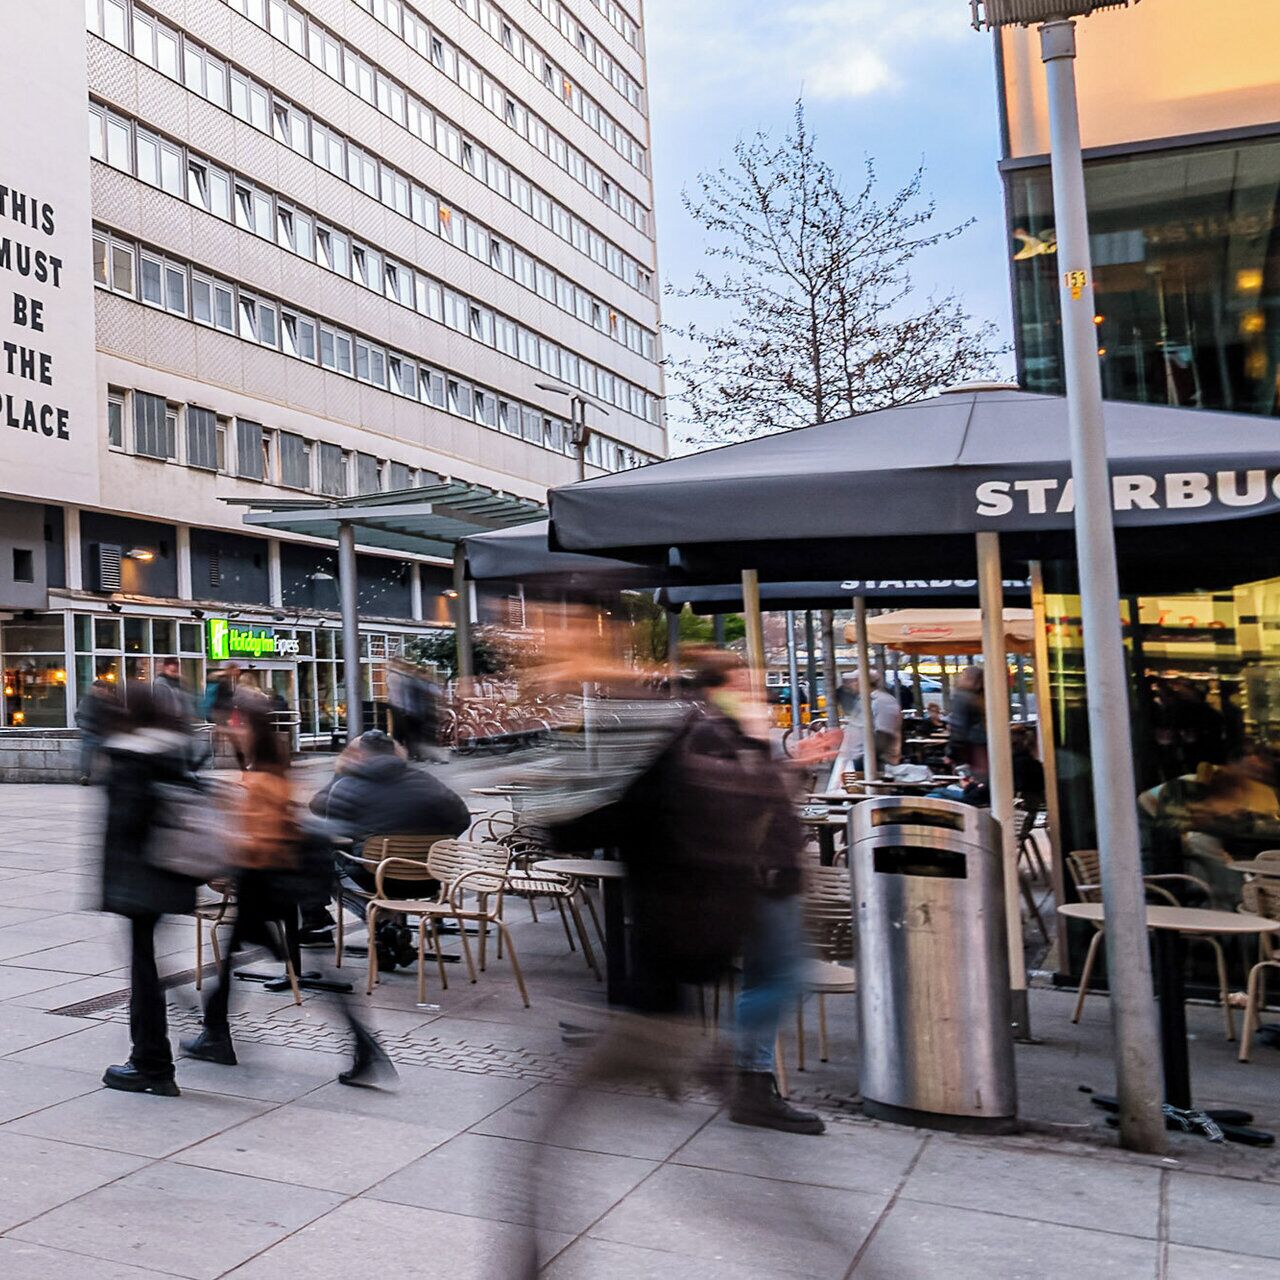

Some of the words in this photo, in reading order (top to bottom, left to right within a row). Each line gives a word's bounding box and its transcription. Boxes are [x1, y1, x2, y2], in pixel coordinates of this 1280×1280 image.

[13, 292, 44, 333] BE
[3, 341, 53, 386] THE
[975, 470, 1280, 517] STRBU
[273, 634, 300, 657] Express
